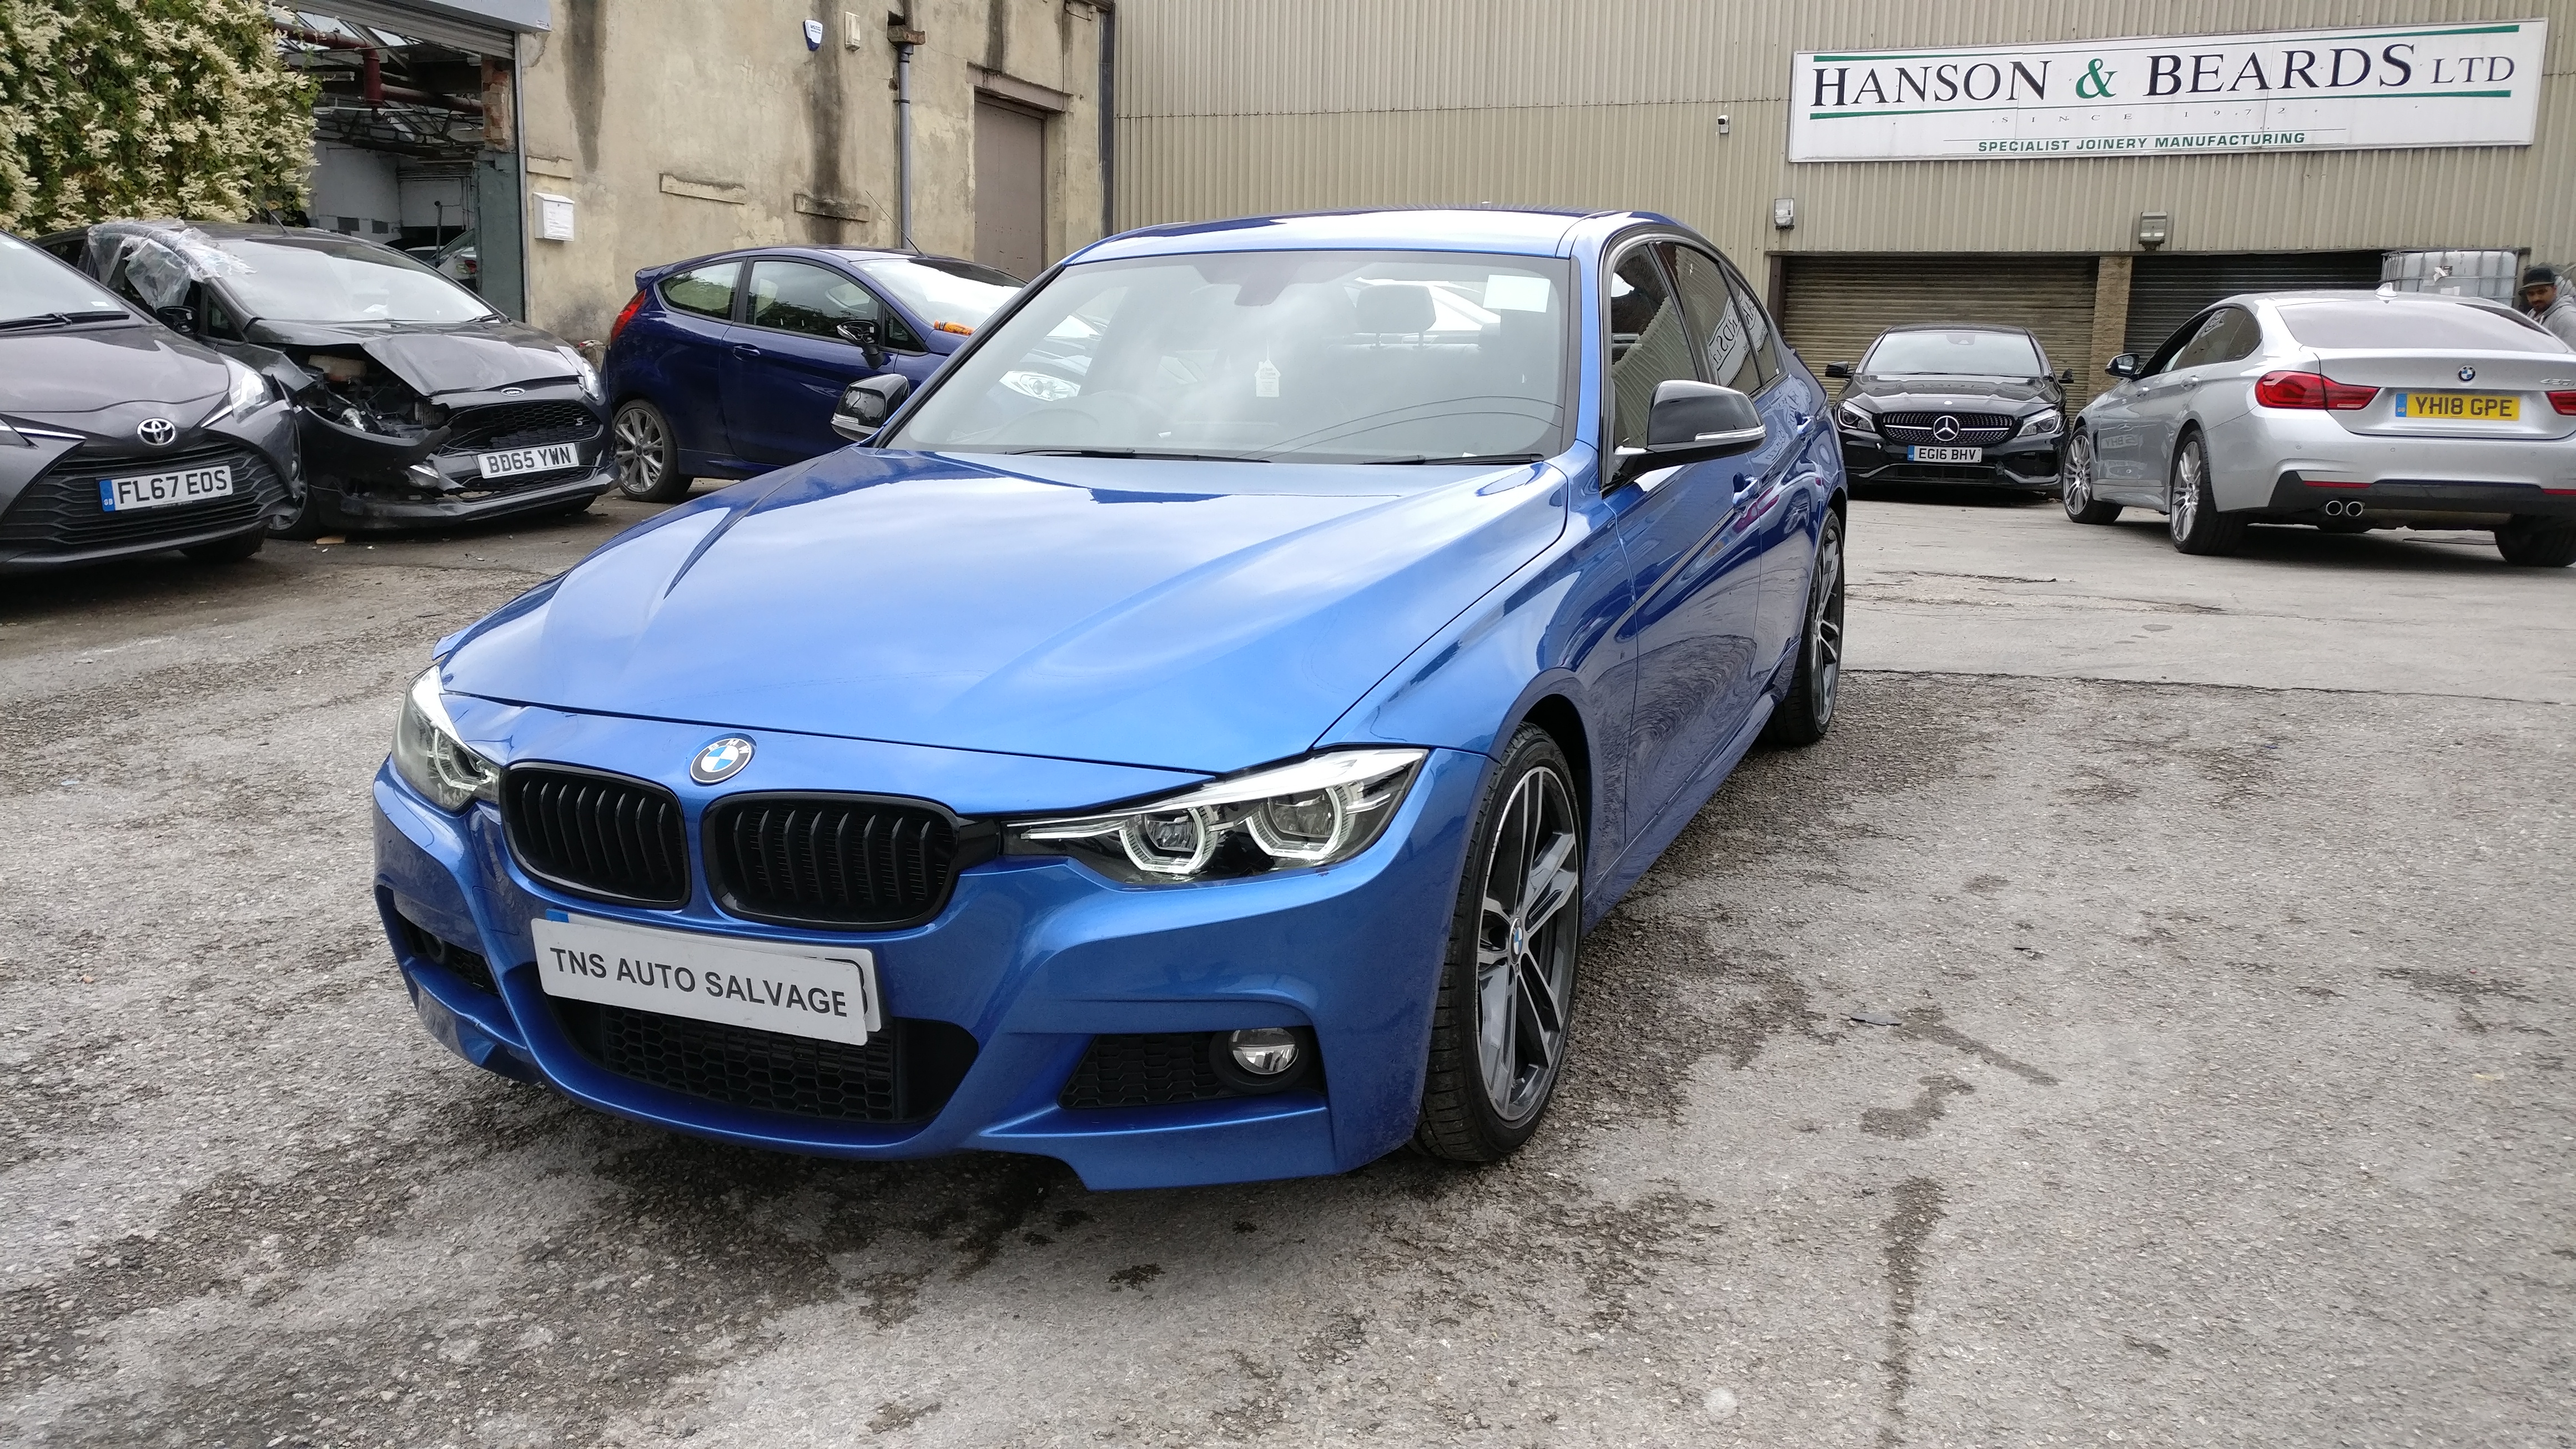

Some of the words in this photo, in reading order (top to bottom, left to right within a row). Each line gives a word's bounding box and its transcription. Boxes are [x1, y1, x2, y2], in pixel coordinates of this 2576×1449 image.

[1810, 60, 2052, 107] HANSON
[2075, 58, 2117, 99] &
[2143, 43, 2416, 97] BEARDS
[2430, 56, 2515, 84] LTD
[2001, 113, 2133, 123] SINCE
[1978, 139, 2070, 152] SPECIALIST
[2076, 137, 2148, 150] JOINERY
[2155, 132, 2306, 148] MANUFACTURING
[2415, 396, 2464, 415] YH18
[2470, 398, 2513, 417] GPE
[486, 450, 535, 474] BD65
[537, 446, 571, 466] YWN
[1919, 447, 1947, 460] EG16
[1950, 449, 1976, 460] BHV
[117, 475, 179, 505] FL67
[185, 469, 227, 495] EOS
[549, 947, 607, 978] TNS
[616, 958, 696, 993] AUTO
[705, 971, 848, 1018] SALVAGE
